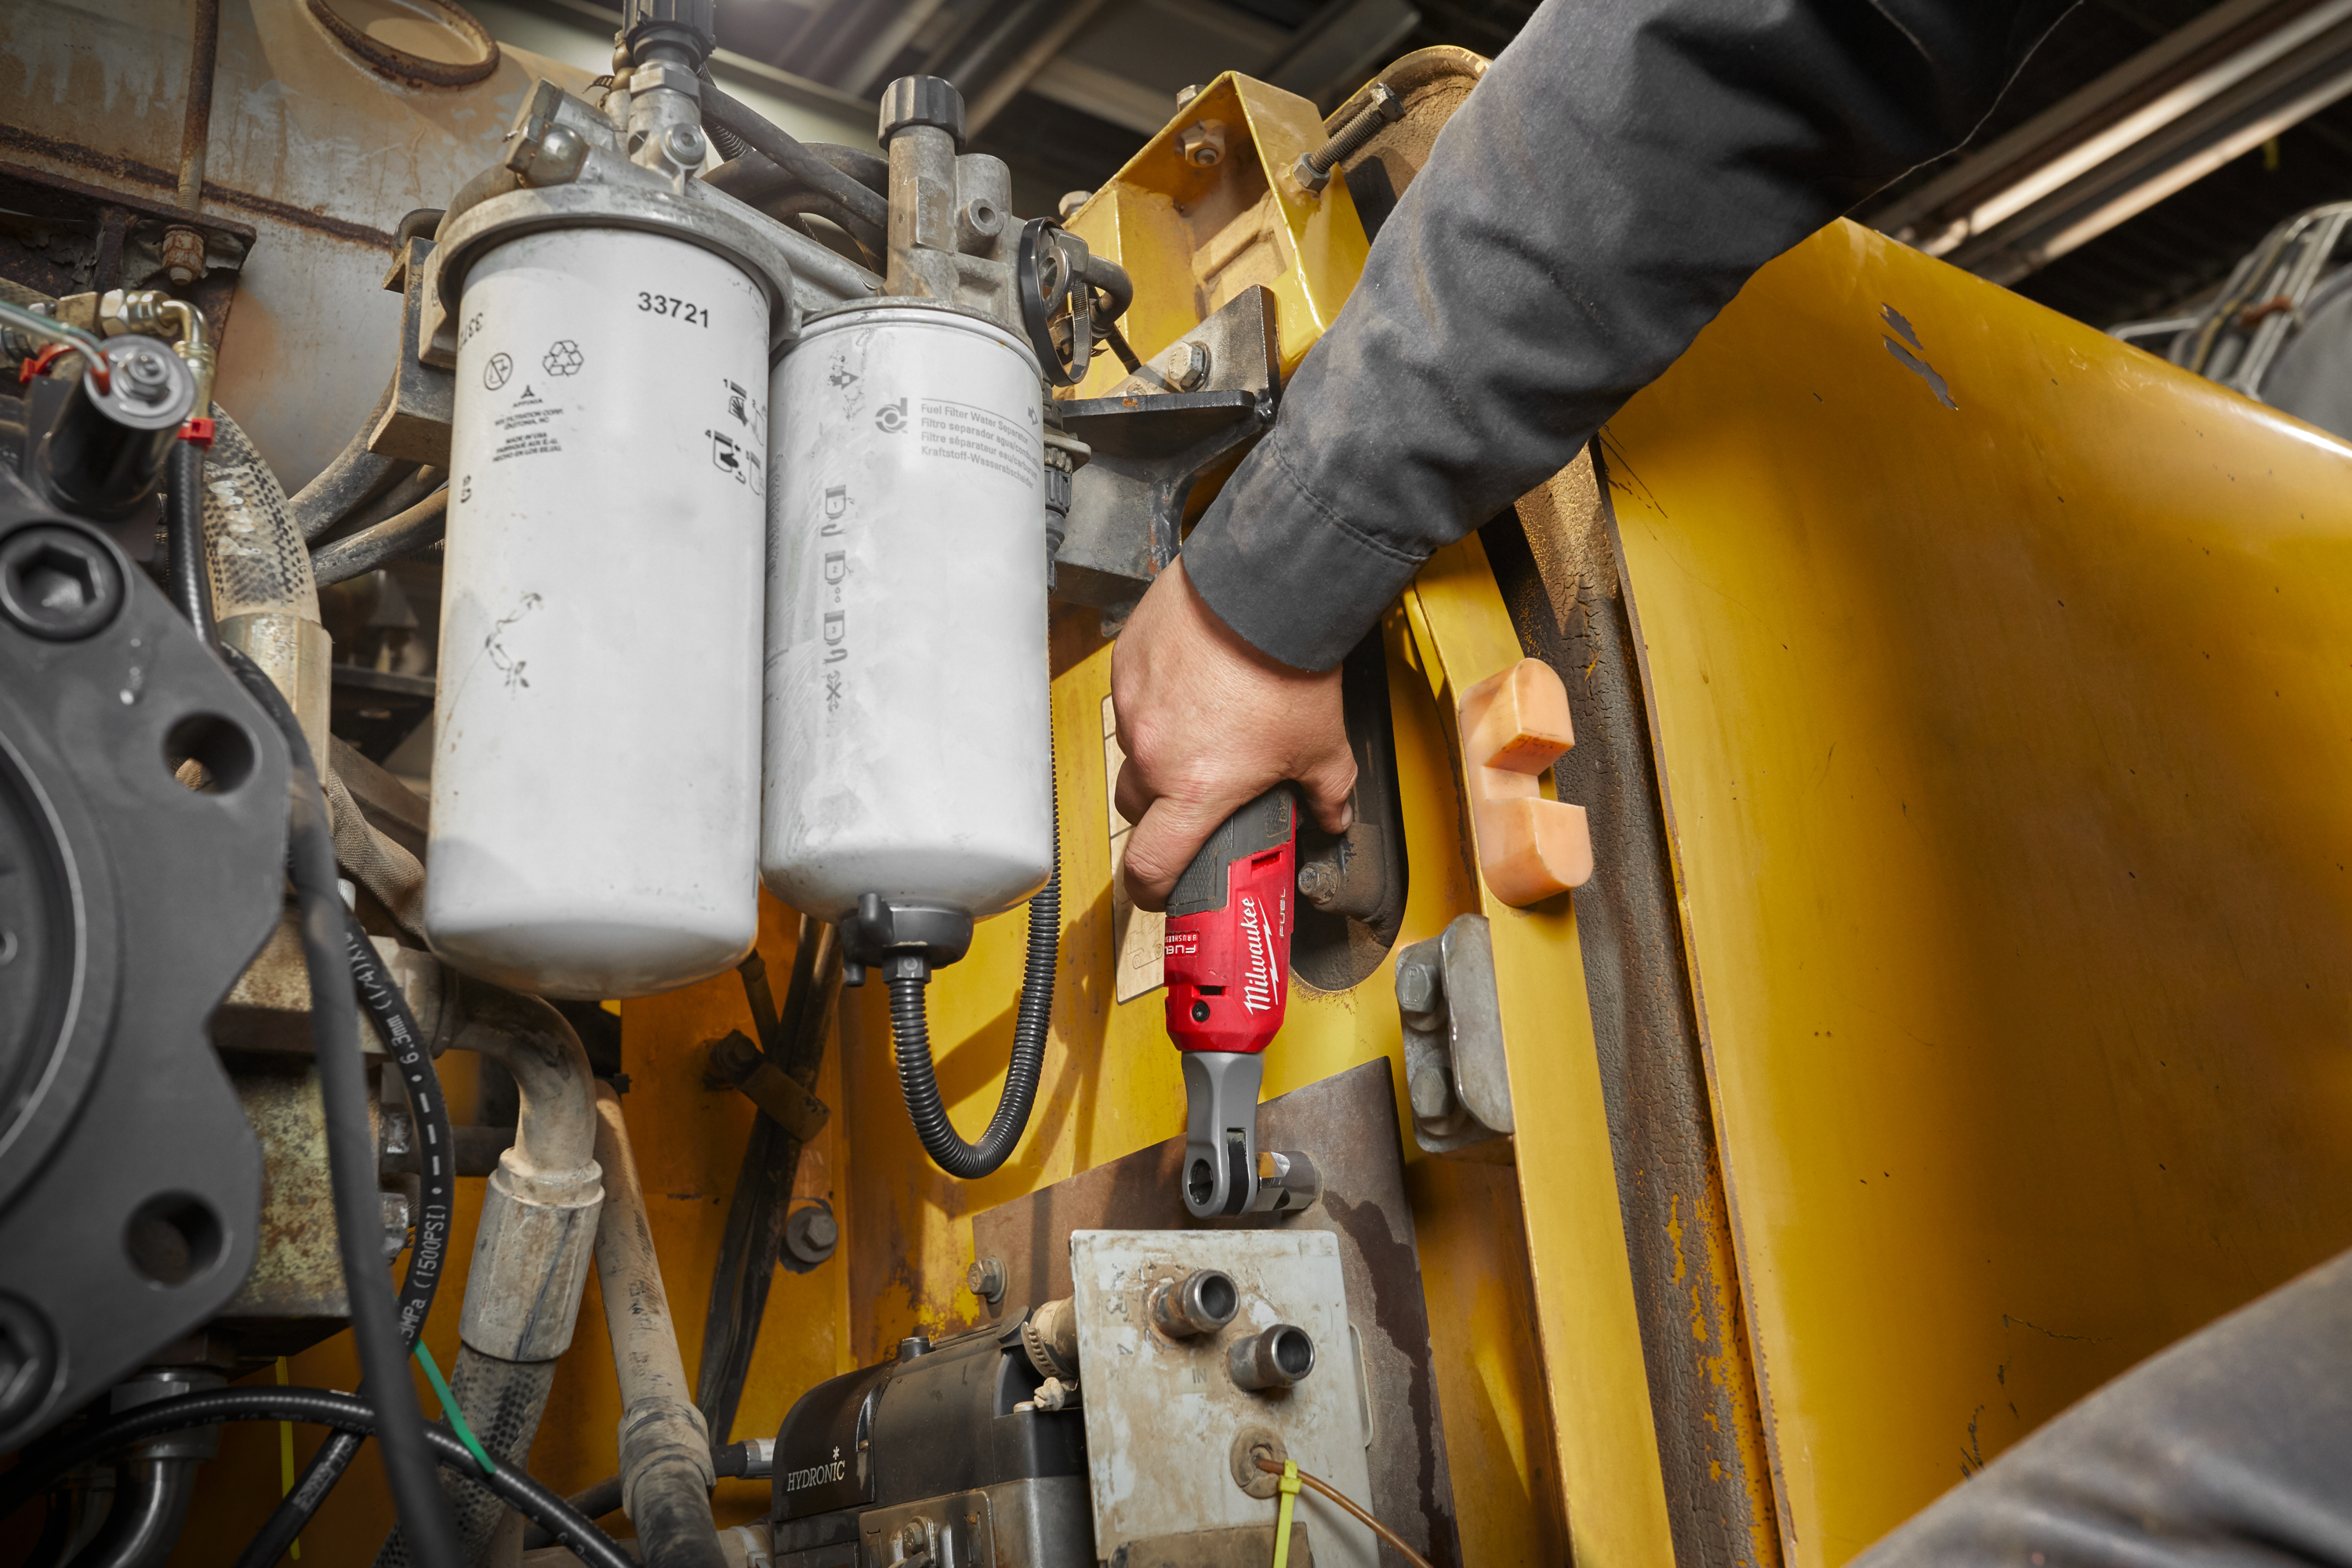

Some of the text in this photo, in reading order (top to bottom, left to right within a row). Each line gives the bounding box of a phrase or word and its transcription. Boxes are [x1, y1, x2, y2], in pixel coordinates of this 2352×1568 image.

[638, 291, 709, 328] 33721
[921, 404, 1029, 445] Fuel Filter Water Separator
[921, 417, 946, 429] Filtro
[949, 422, 994, 441] separador
[921, 432, 946, 443] Filtre
[949, 436, 997, 456] séparateur
[921, 445, 1033, 490] Kraftstoff-Wasserabscheider
[1165, 934, 1196, 942] BRUSHLES
[1165, 944, 1196, 955] FUEL
[1240, 896, 1271, 1015] Milwaukee
[387, 1014, 419, 1064] 6.3mm
[400, 1204, 447, 1346] .3MPa (1500PSI)
[1192, 1368, 1208, 1384] IN
[787, 1461, 845, 1491] HYDRONIC
